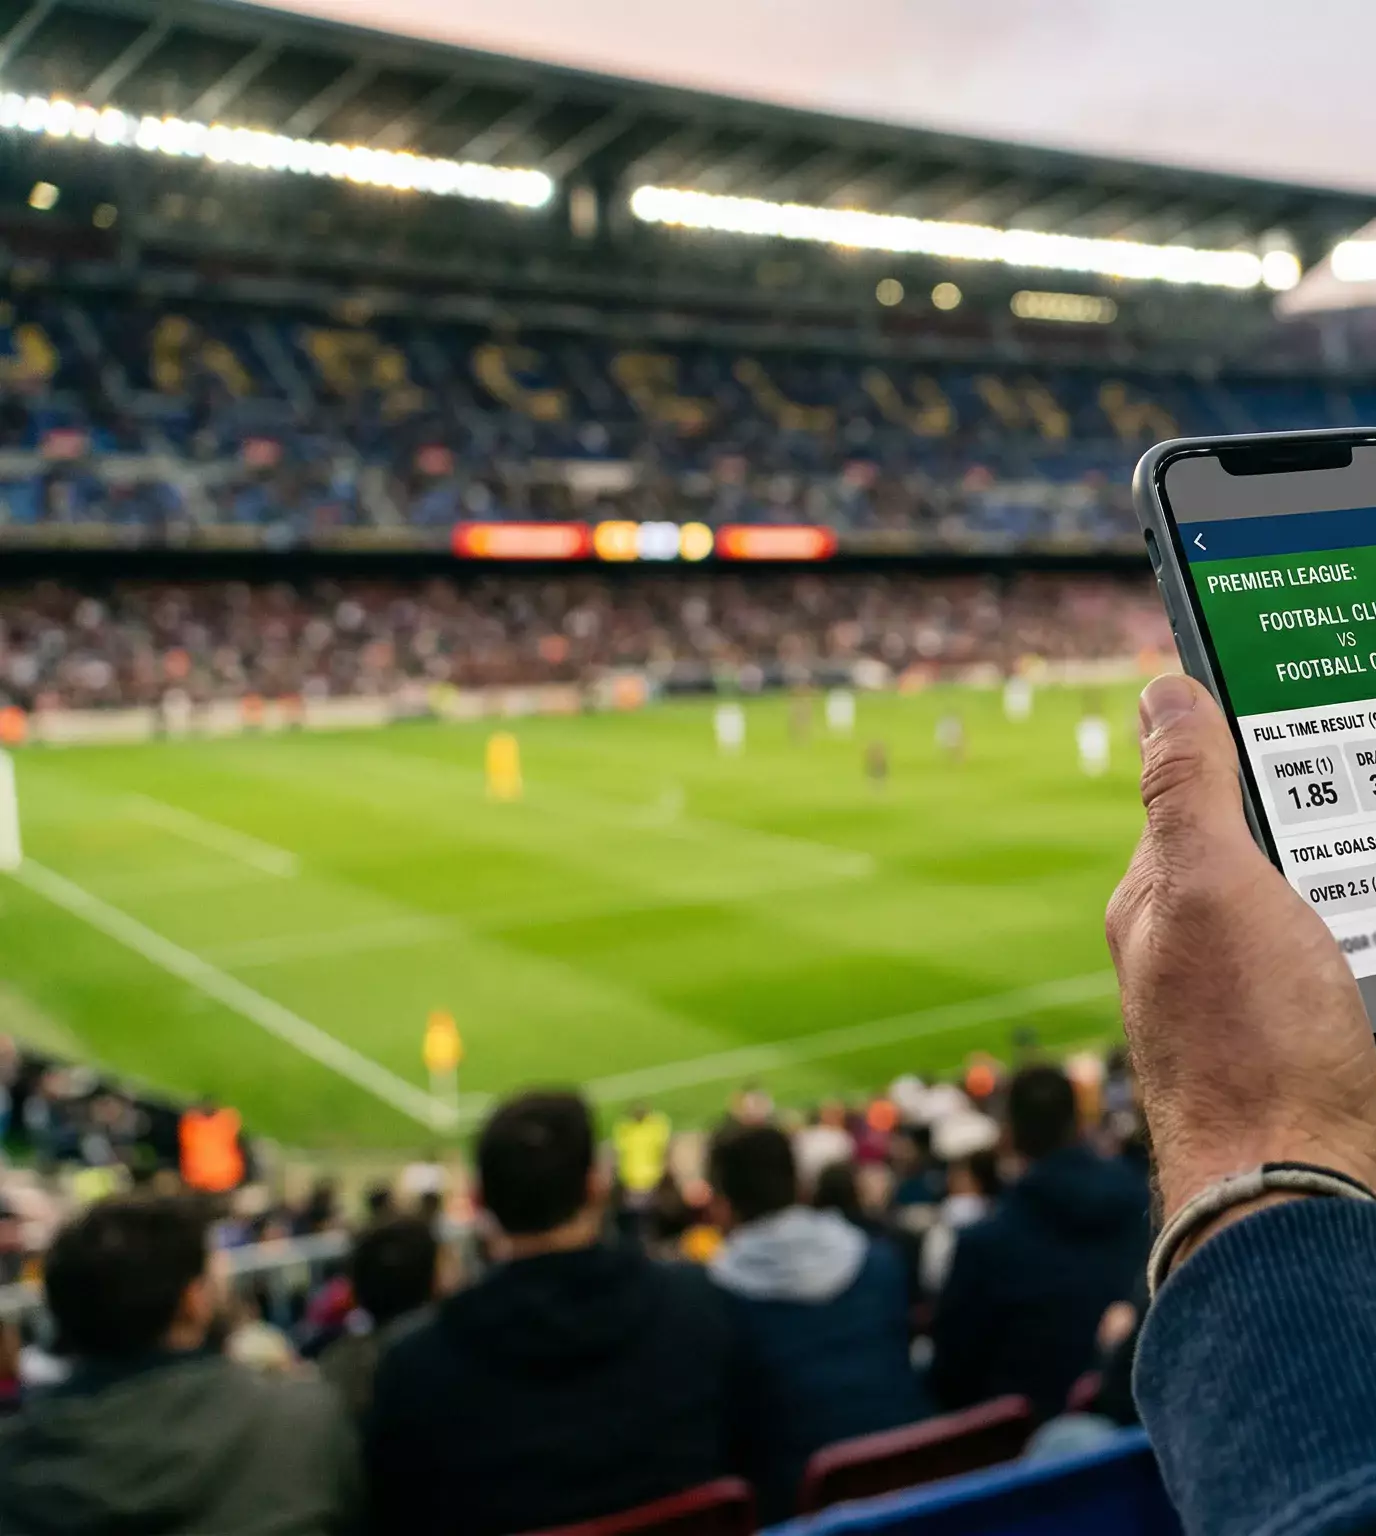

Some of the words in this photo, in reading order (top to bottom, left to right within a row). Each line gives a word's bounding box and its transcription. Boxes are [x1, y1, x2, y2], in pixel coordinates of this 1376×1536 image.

[1207, 570, 1284, 593] PREMIER
[1287, 564, 1357, 585] LEAGUE:
[1259, 606, 1349, 631] FOOTBALL
[1337, 632, 1356, 646] VS
[1276, 655, 1366, 681] FOOTBALL
[1254, 726, 1286, 741] FULL
[1286, 721, 1319, 737] TIME
[1321, 714, 1364, 732] RESULT
[1275, 760, 1314, 778] HOME
[1316, 757, 1333, 775] (1)
[1288, 781, 1337, 809] 1.85
[1290, 845, 1332, 862] TOTAL
[1310, 884, 1346, 902] OVER
[1348, 880, 1369, 896] 2.5
